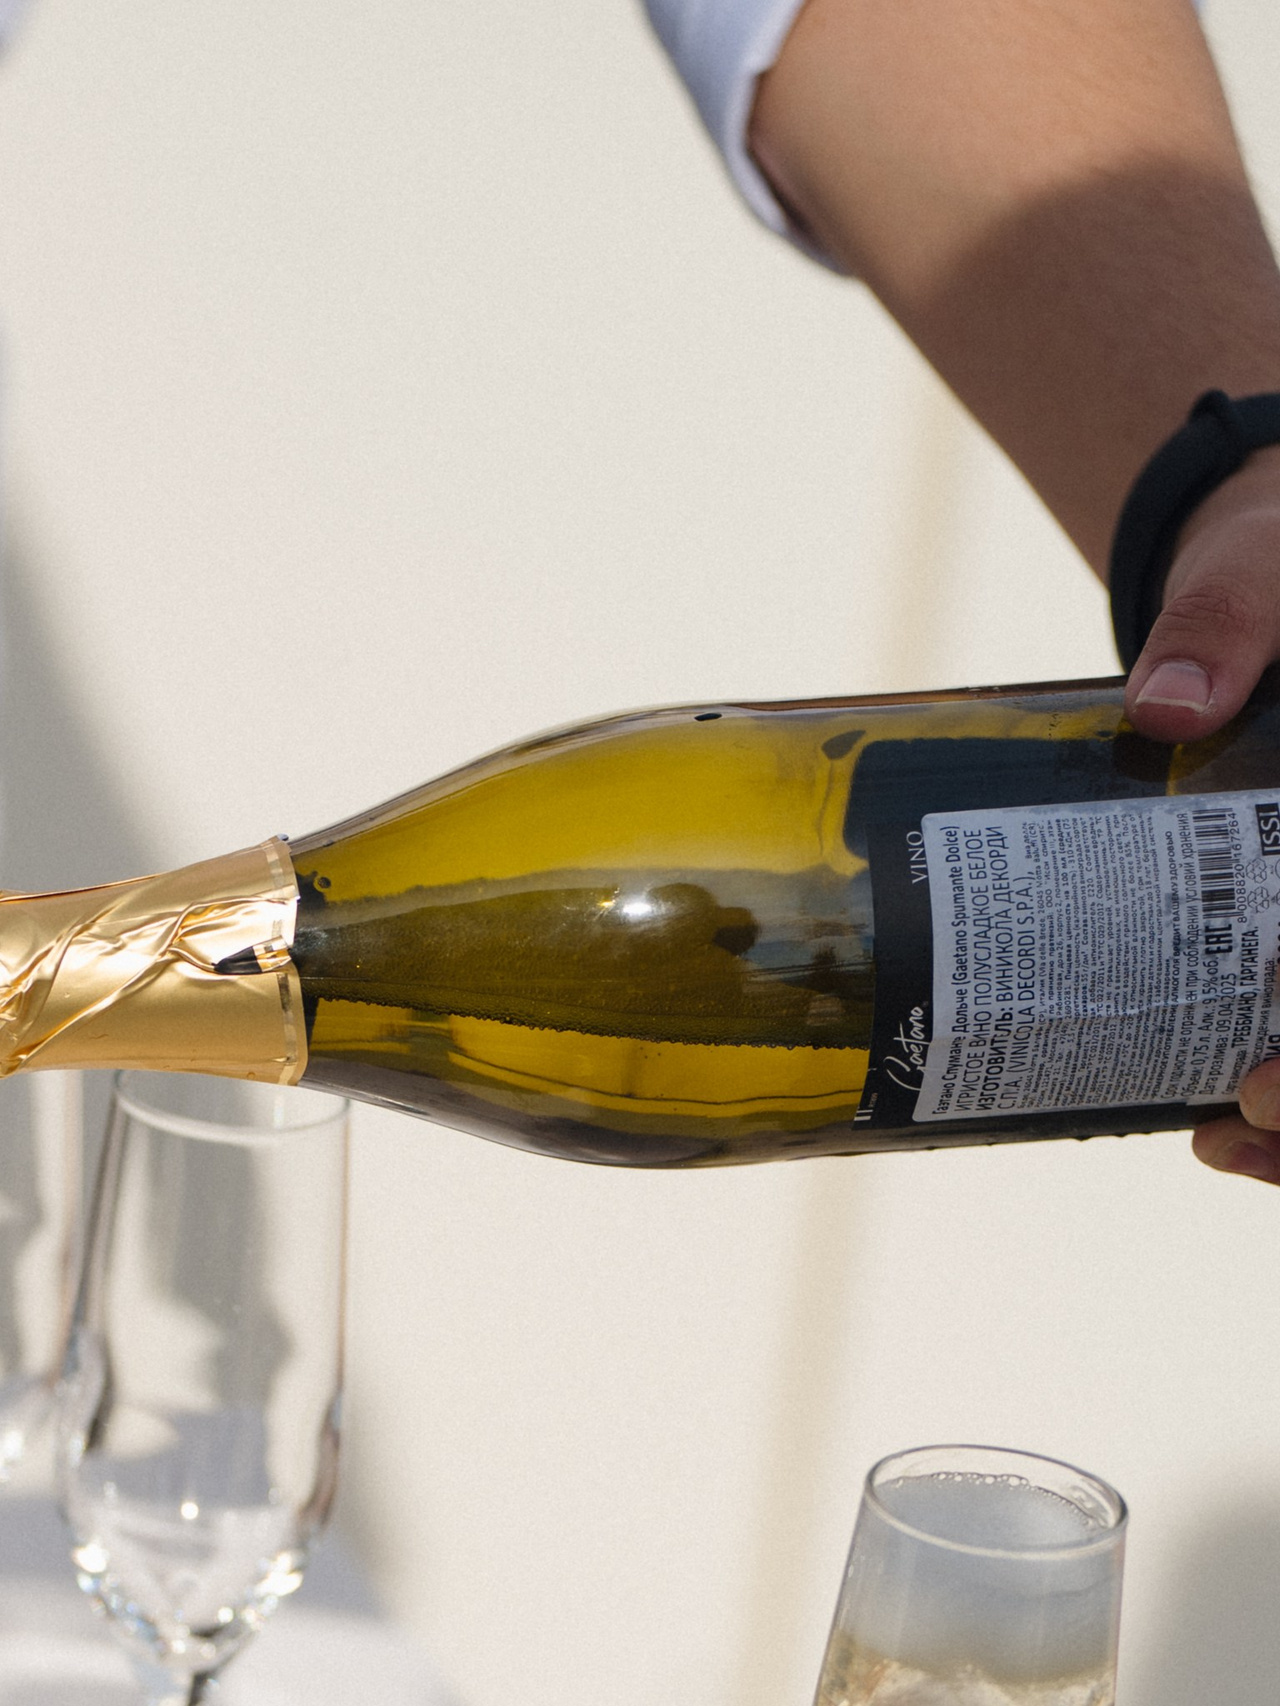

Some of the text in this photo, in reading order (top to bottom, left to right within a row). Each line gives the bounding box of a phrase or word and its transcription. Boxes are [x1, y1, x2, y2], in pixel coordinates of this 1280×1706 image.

[905, 830, 927, 883] VINO
[1164, 830, 1178, 880] ЗДОРОВЬЮ
[1176, 812, 1196, 859] хранения
[1227, 812, 1242, 857] 167264
[1049, 849, 1061, 898] помещение
[1074, 843, 1085, 884] винограда
[1178, 861, 1201, 903] условий
[1233, 863, 1247, 911] 008820
[1012, 871, 1035, 925] S.P.A.),
[1036, 890, 1045, 913] 26045
[1063, 903, 1072, 940] ценность
[1079, 895, 1087, 914] вино
[1170, 881, 1180, 922] ВАШЕМУ
[1055, 908, 1063, 937] корпус
[1088, 901, 1097, 966] антиокислитель
[1171, 922, 1181, 957] ВРЕДИТ
[1182, 905, 1202, 967] соблюдении
[1203, 923, 1233, 955] EAC
[931, 825, 970, 1114] Гаэтано Спуманте Дольче (Gaetano Spumante Dolce)
[954, 829, 994, 1111] ИГРИСТОЕ ВИНО ПОЛУСЛАДКОЕ БЕЛОЕ
[976, 825, 1014, 1110] ИЗГОТОВИТЕЛЬ: ВИНИКОЛА ДЕКОРДИ
[1016, 929, 1035, 1001] DECORDI
[1129, 945, 1137, 1002] относительной
[1184, 969, 1201, 987] при
[1201, 955, 1219, 975] об.
[1239, 926, 1259, 986] ГАРГАНЕГА.
[1089, 970, 1097, 1003] добавка
[1170, 958, 1180, 1002] АЛКОГОЛЯ
[1201, 976, 1221, 1005] 9,5%
[1261, 957, 1277, 1008] винограда:
[1006, 1005, 1035, 1073] (VINICOLA
[1197, 972, 1236, 1095] Дата розлива: 09.04.2025
[1230, 987, 1260, 1048] ТРЕББИАНО,
[883, 1006, 931, 1090] Gaetano
[1177, 1036, 1191, 1047] не
[1189, 1044, 1209, 1065] 0,75
[996, 1075, 1023, 1109] С.П.А.
